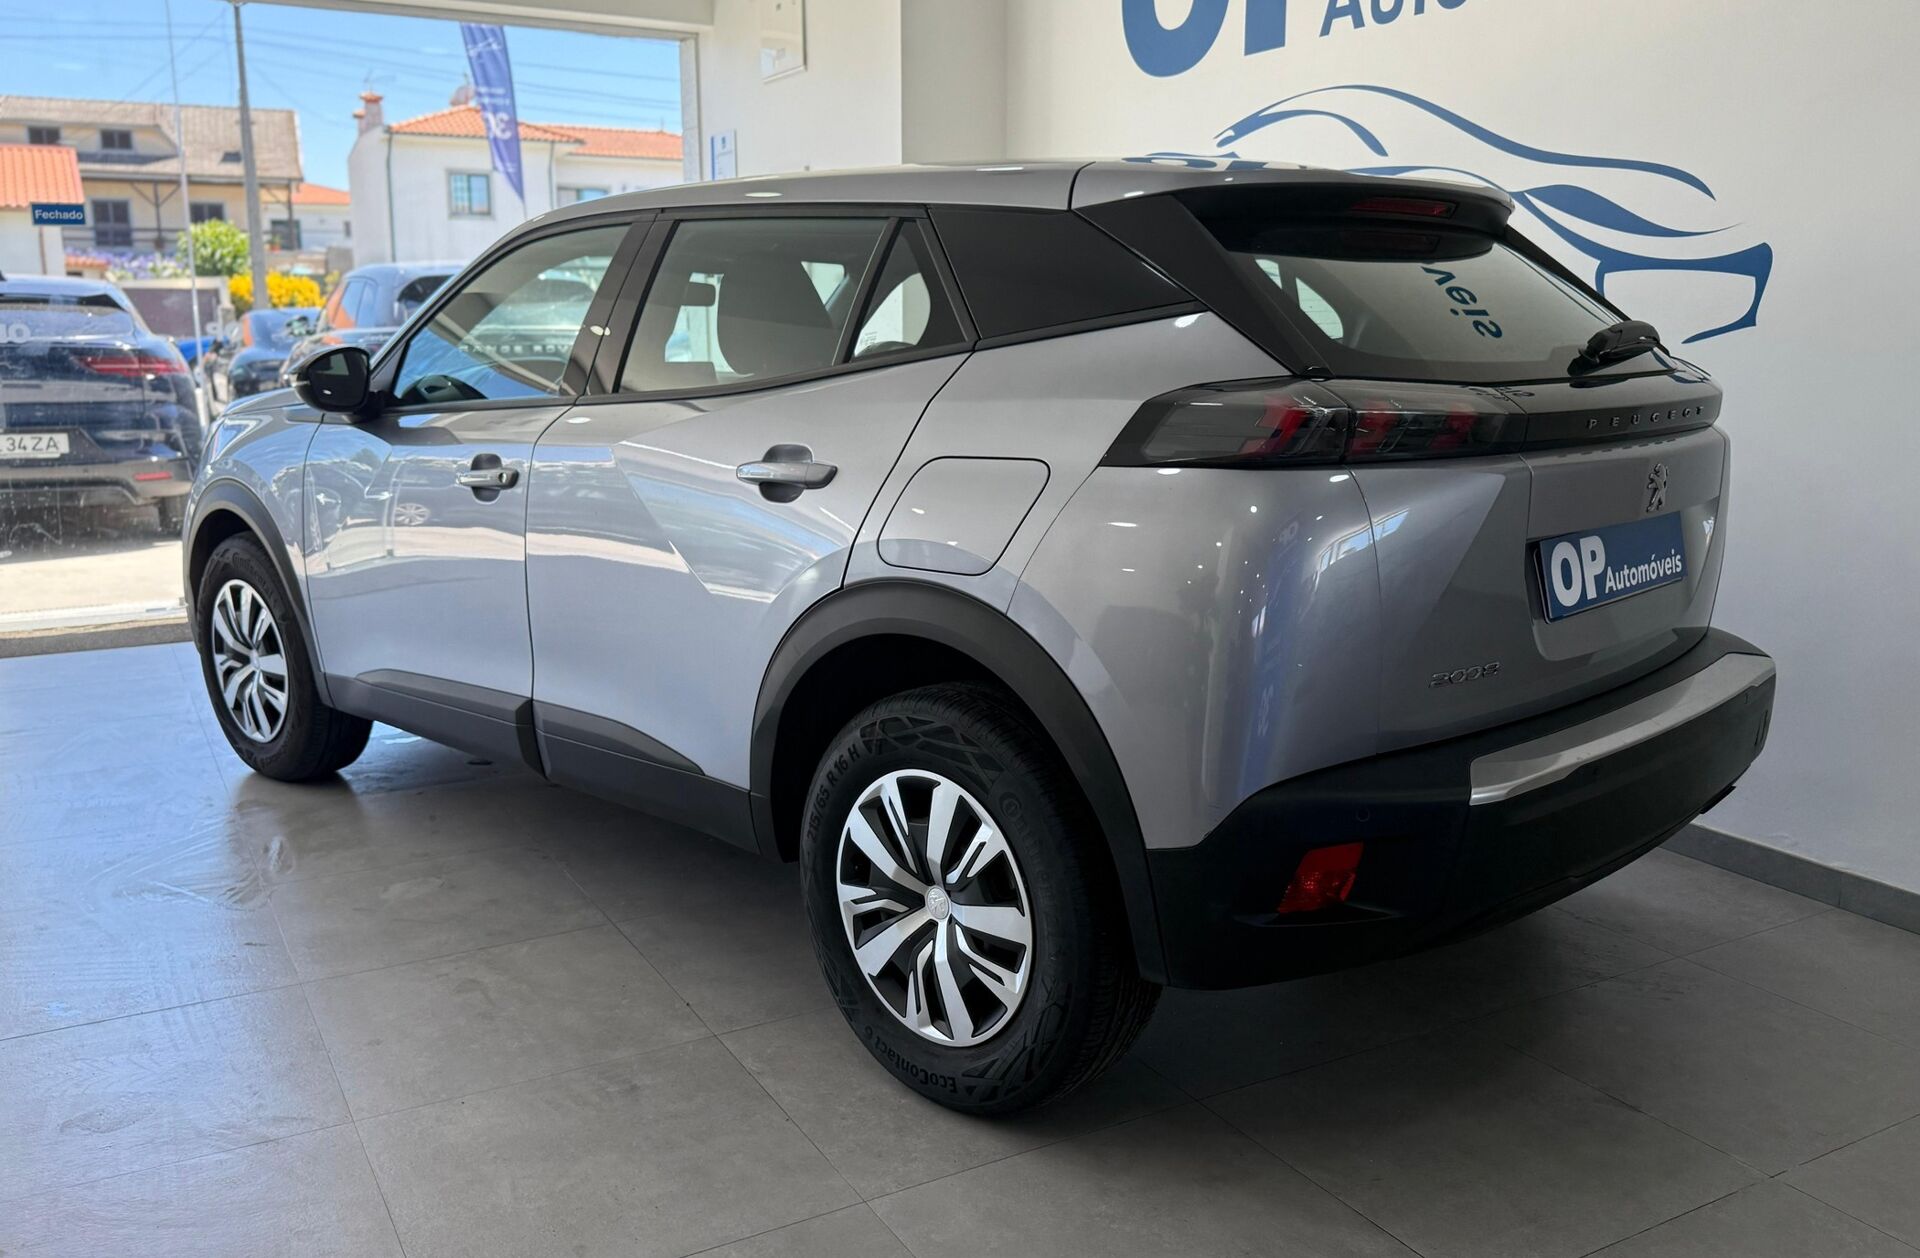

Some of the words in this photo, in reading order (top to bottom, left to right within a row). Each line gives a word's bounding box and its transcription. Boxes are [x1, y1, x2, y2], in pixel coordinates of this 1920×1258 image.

[34, 209, 84, 220] Fechado
[1585, 405, 1704, 430] PEUGEOT
[1551, 535, 1606, 607] OP
[1605, 549, 1682, 594] Automóveis
[1428, 661, 1501, 688] 2008
[806, 785, 830, 843] 215/65
[874, 1036, 958, 1094] EcoContact
